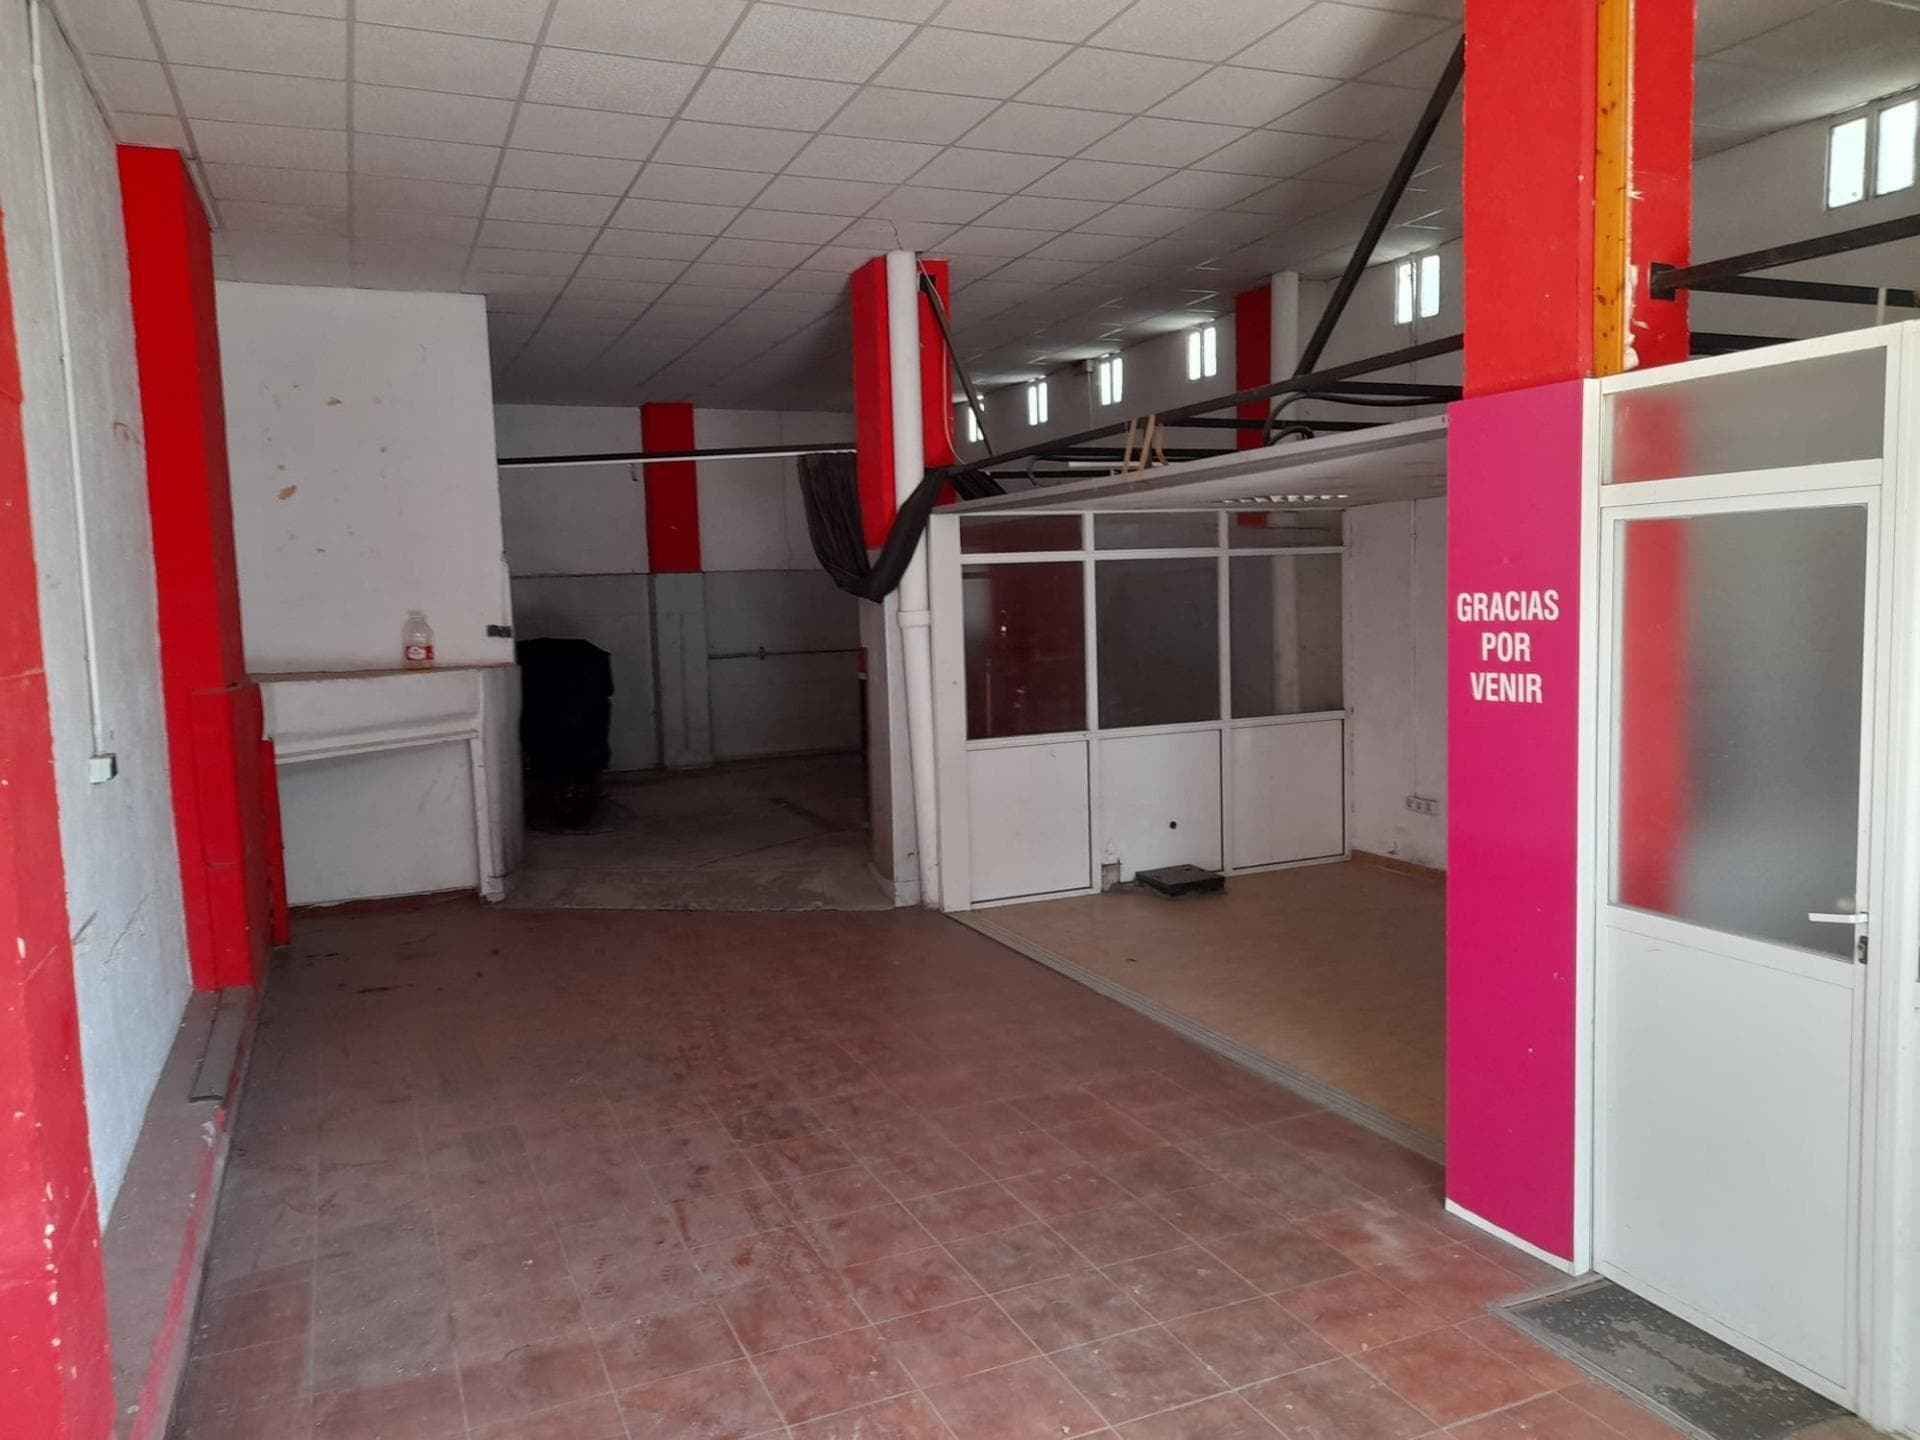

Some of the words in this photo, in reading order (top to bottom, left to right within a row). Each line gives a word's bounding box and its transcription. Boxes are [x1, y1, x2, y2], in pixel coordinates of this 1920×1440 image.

[1457, 589, 1559, 622] GRACIAS
[1481, 631, 1531, 662] POR
[1470, 672, 1543, 704] VENIR
